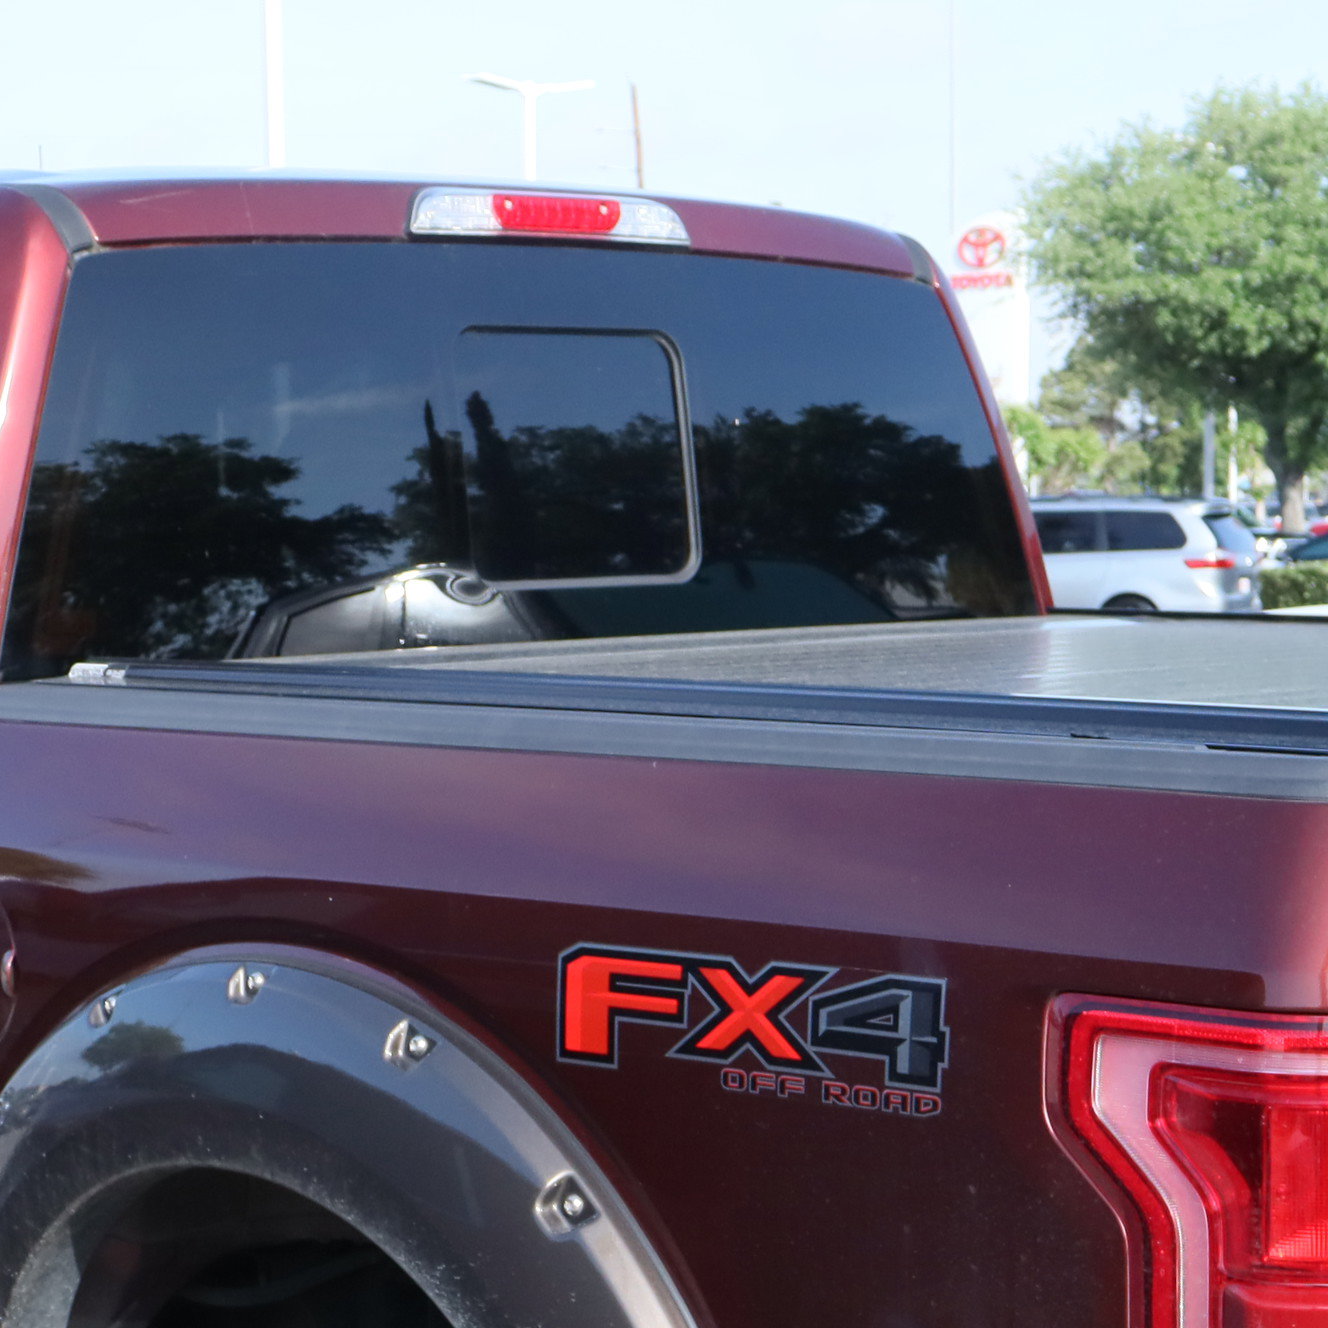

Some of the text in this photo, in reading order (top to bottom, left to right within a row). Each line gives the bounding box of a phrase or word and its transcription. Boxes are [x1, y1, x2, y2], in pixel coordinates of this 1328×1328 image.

[557, 941, 951, 1093] FX4
[720, 1067, 942, 1118] OFF ROAD
